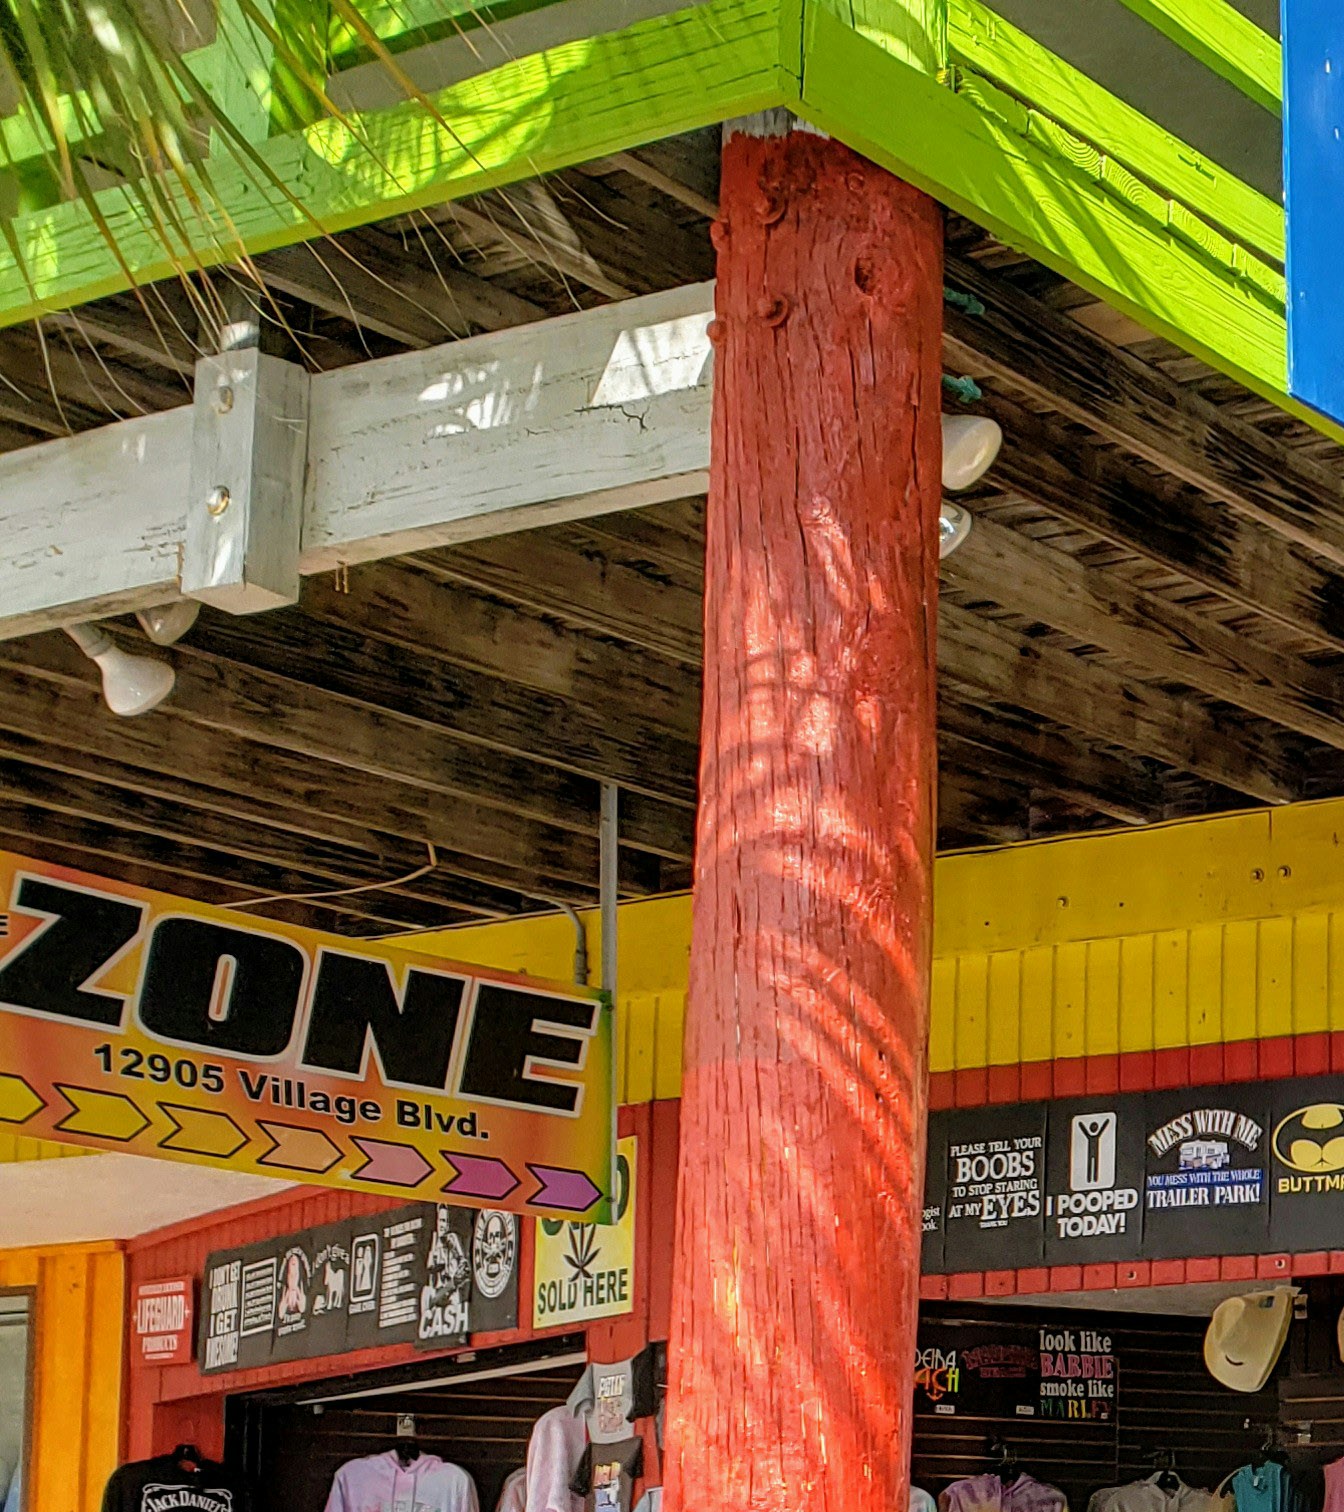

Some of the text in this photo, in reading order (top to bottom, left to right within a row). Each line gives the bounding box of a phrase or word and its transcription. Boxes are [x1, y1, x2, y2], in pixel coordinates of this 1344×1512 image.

[0, 870, 601, 1117] ZONE
[94, 1042, 489, 1140] 12905 Village Blvd.
[950, 1136, 1042, 1157] PLEASE TELL YOUR
[1147, 1108, 1238, 1158] MESS WITH
[956, 1150, 1035, 1183] BOOBS
[1164, 1168, 1261, 1186] MESS WITH THE WHOLE
[951, 1178, 1038, 1198] TO STOP STARING
[1147, 1182, 1261, 1209] TRAILER PARK!
[949, 1204, 964, 1218] AT
[964, 1202, 982, 1216] MY
[980, 1190, 1040, 1220] EYES
[1056, 1188, 1138, 1216] POOPED
[1057, 1212, 1126, 1239] TODAY!
[537, 1267, 628, 1314] SOLD HERE
[216, 1309, 238, 1335] GET
[419, 1300, 469, 1340] CASH
[1039, 1329, 1112, 1353] look like
[1040, 1352, 1114, 1379] BARBIE
[1039, 1379, 1114, 1398] smoke like
